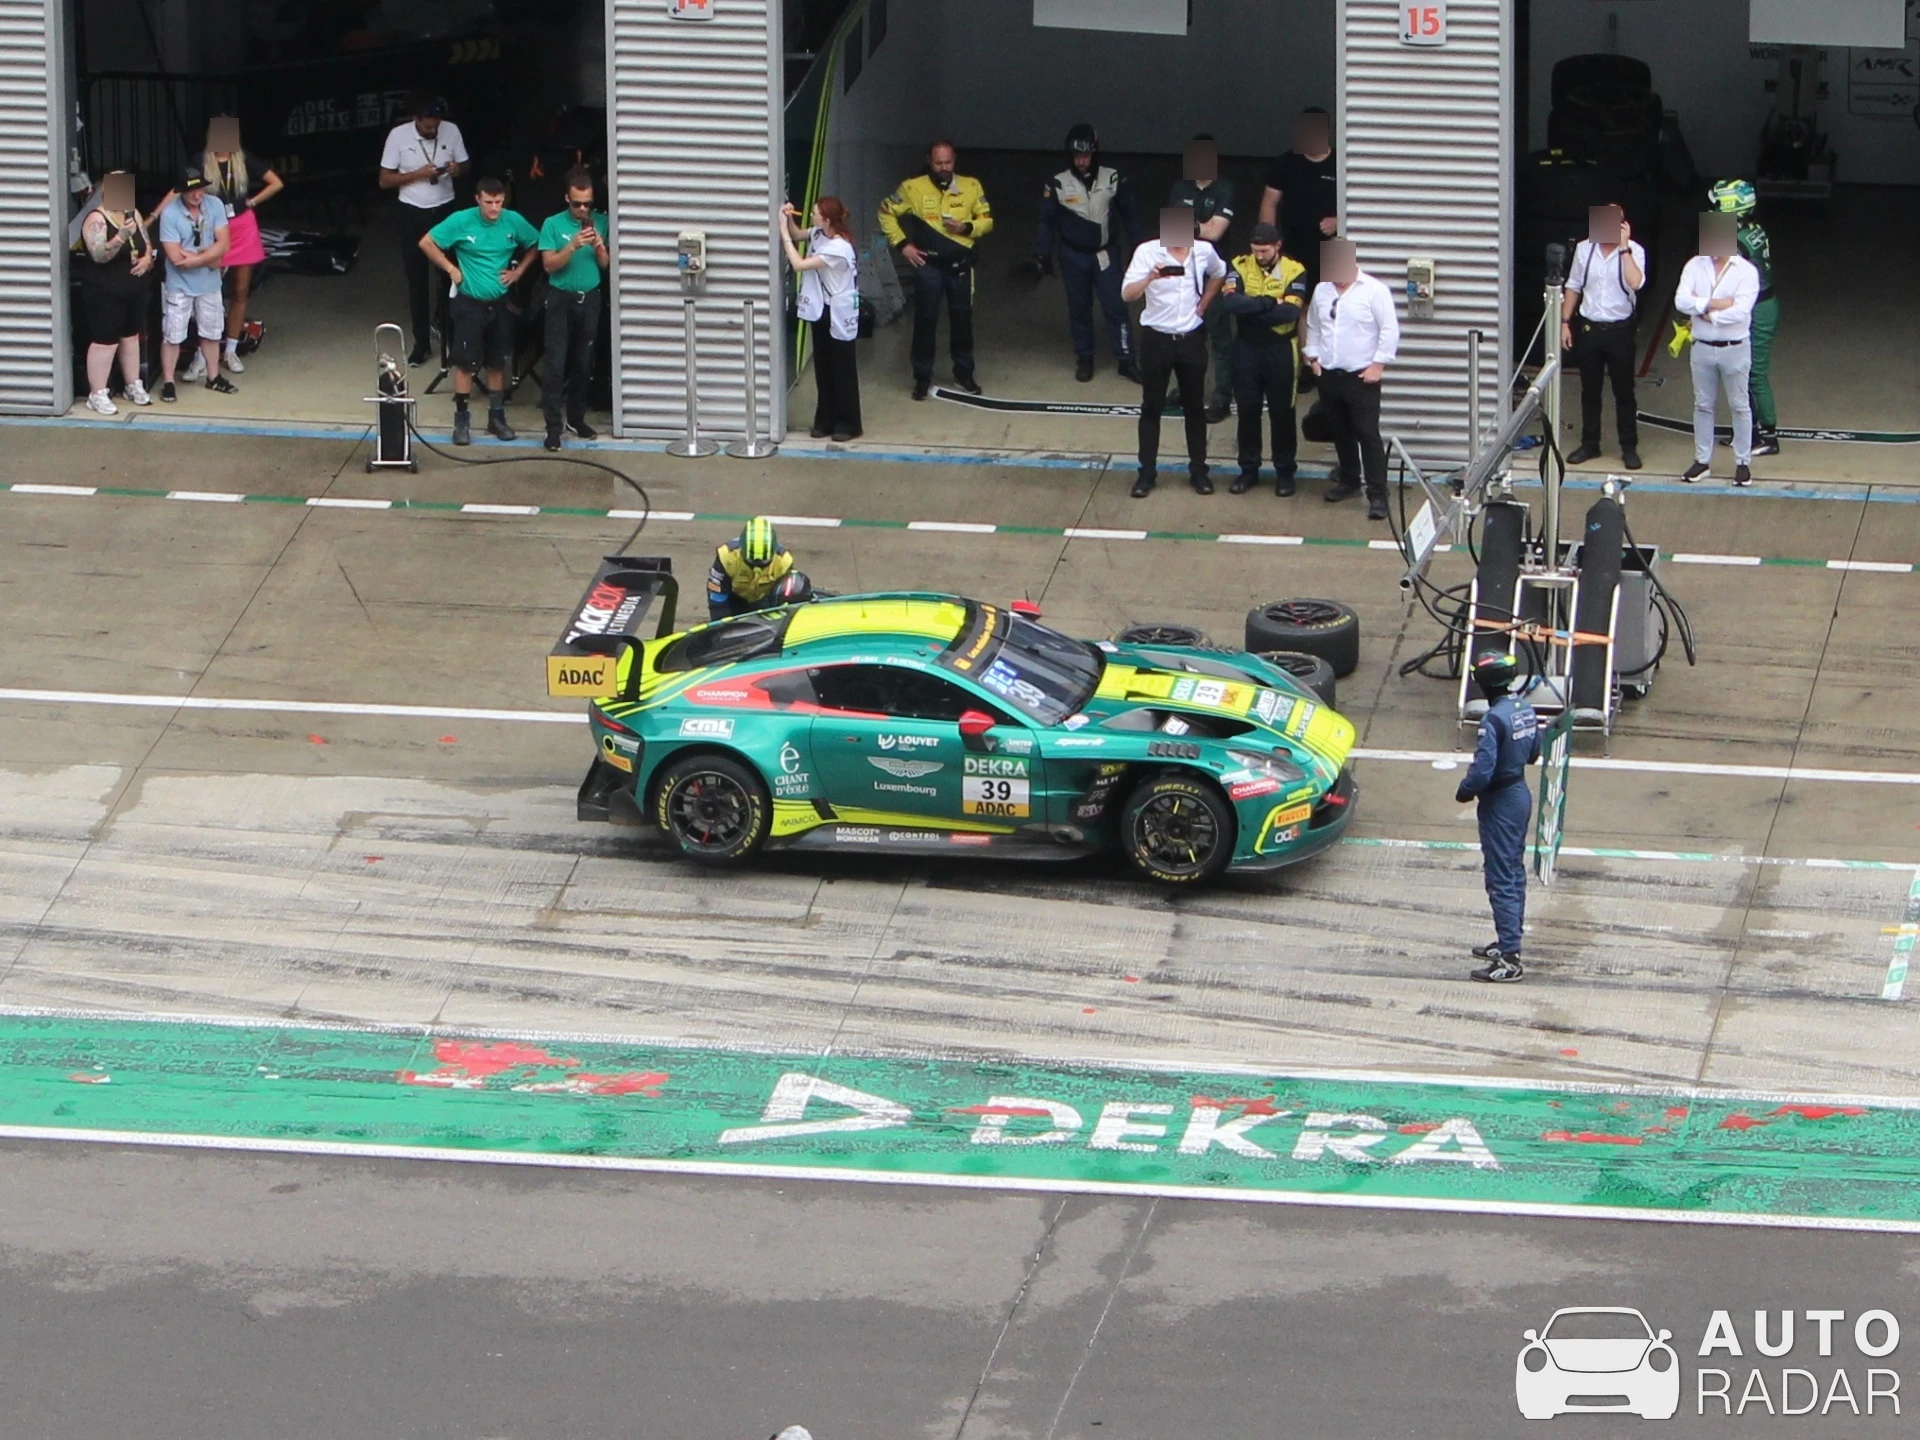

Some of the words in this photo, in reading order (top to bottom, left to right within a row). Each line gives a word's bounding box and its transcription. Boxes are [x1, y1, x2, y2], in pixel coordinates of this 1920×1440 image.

[1407, 7, 1440, 35] 15
[558, 669, 604, 686] ADAC
[697, 689, 748, 699] CHAMPION
[1008, 679, 1046, 708] 39
[1197, 686, 1219, 700] 39
[964, 757, 1028, 777] DEKRA
[774, 772, 810, 787] CHANT
[1231, 780, 1276, 795] CHAMPION
[874, 780, 936, 797] Luxembourg
[981, 780, 1012, 801] 39
[1153, 783, 1202, 795] PIRELLI
[658, 775, 679, 831] PIRELLI
[975, 802, 1016, 816] ADAC
[836, 835, 880, 844] WORKWEAR
[967, 1094, 1501, 1171] DEKRA
